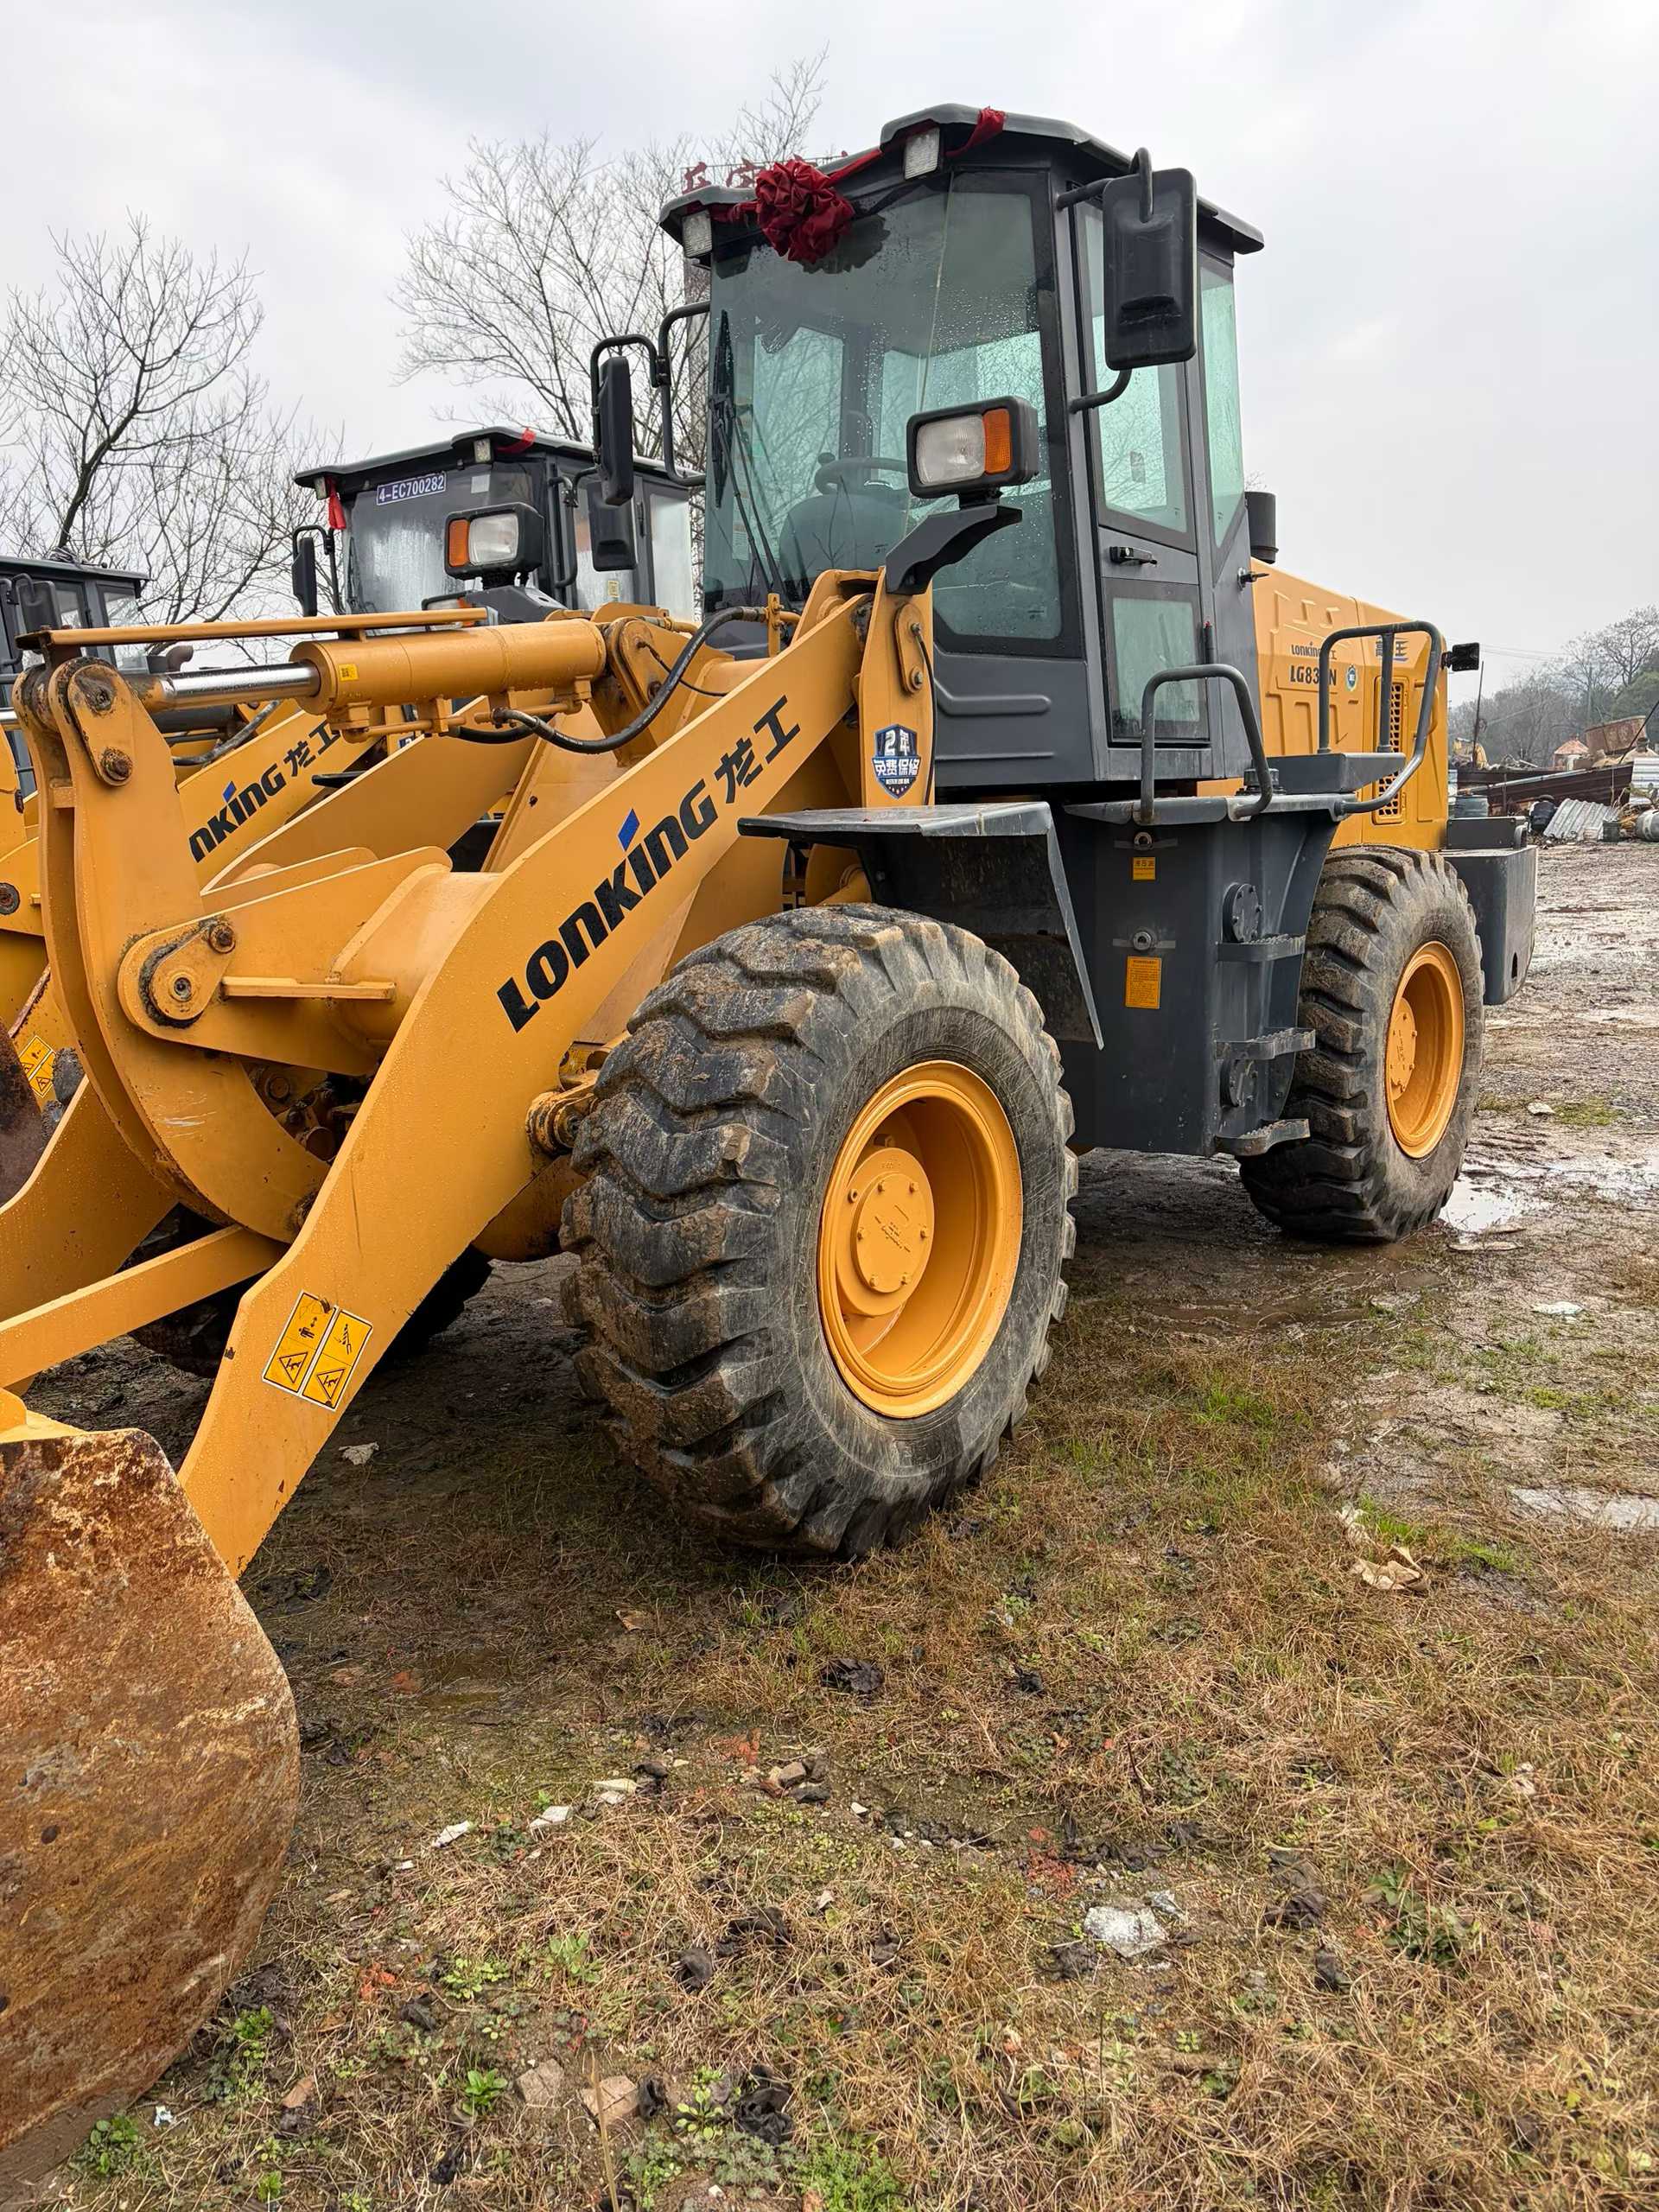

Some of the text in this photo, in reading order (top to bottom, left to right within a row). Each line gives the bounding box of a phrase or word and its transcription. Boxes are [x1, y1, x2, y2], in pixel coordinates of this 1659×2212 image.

[378, 474, 445, 502] 4-EC700282
[1290, 664, 1337, 686] LG83N
[283, 720, 341, 777] 龙工
[714, 695, 801, 804] 龙工
